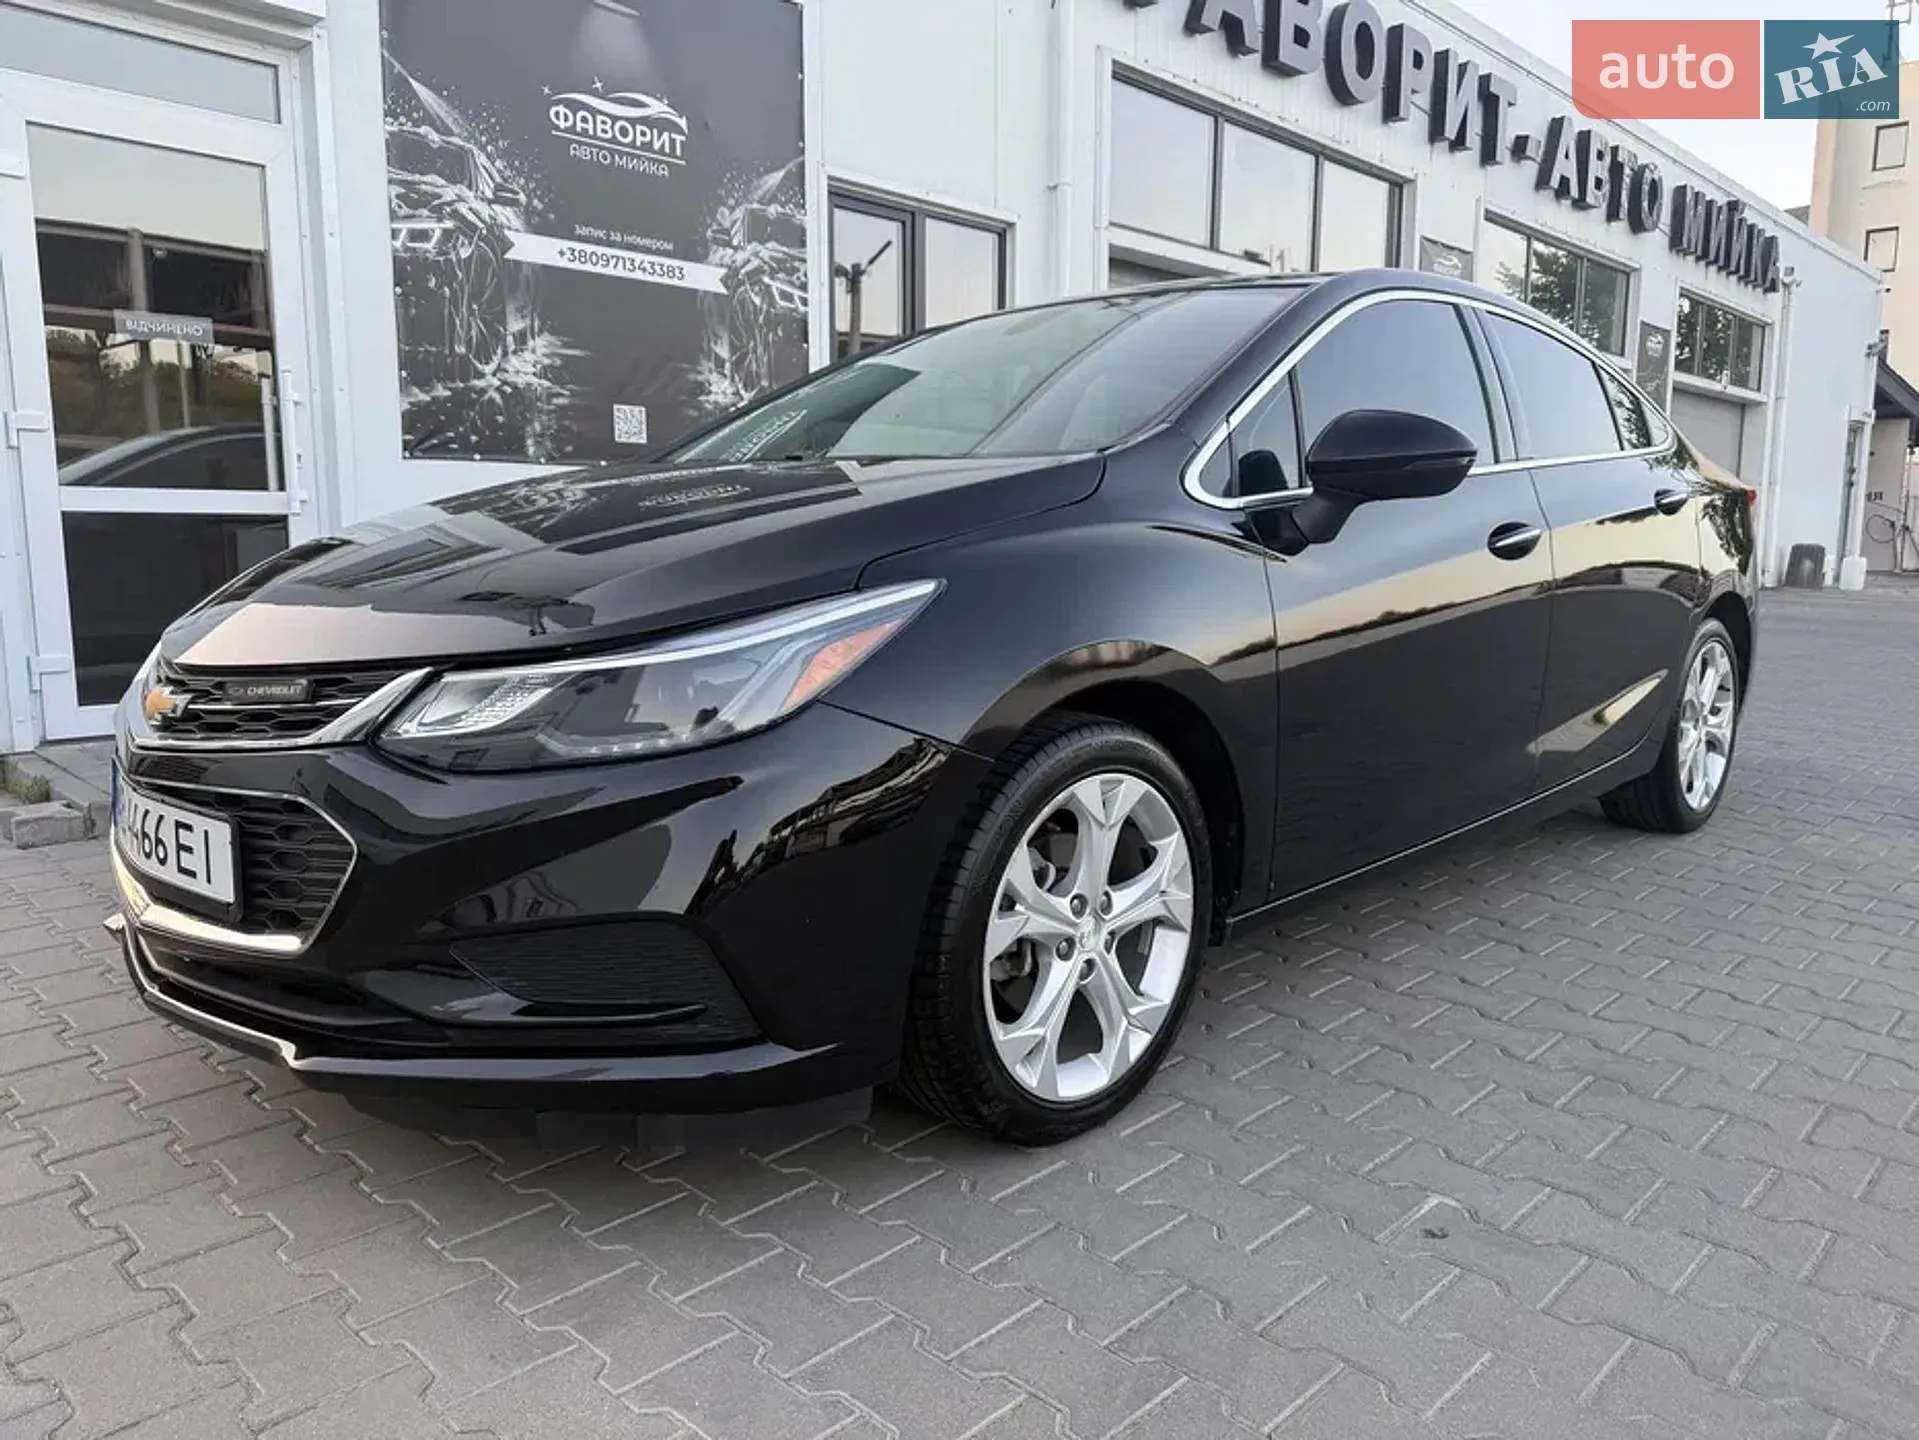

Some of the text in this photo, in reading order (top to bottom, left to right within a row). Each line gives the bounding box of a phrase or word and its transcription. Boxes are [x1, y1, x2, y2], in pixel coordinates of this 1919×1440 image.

[550, 104, 686, 156] ФАВОРИТ
[569, 143, 670, 178] АВТО МИЙКА
[574, 224, 674, 251] запис за номером
[1669, 184, 1781, 294] МИЙКА
[557, 247, 685, 280] +380971343383
